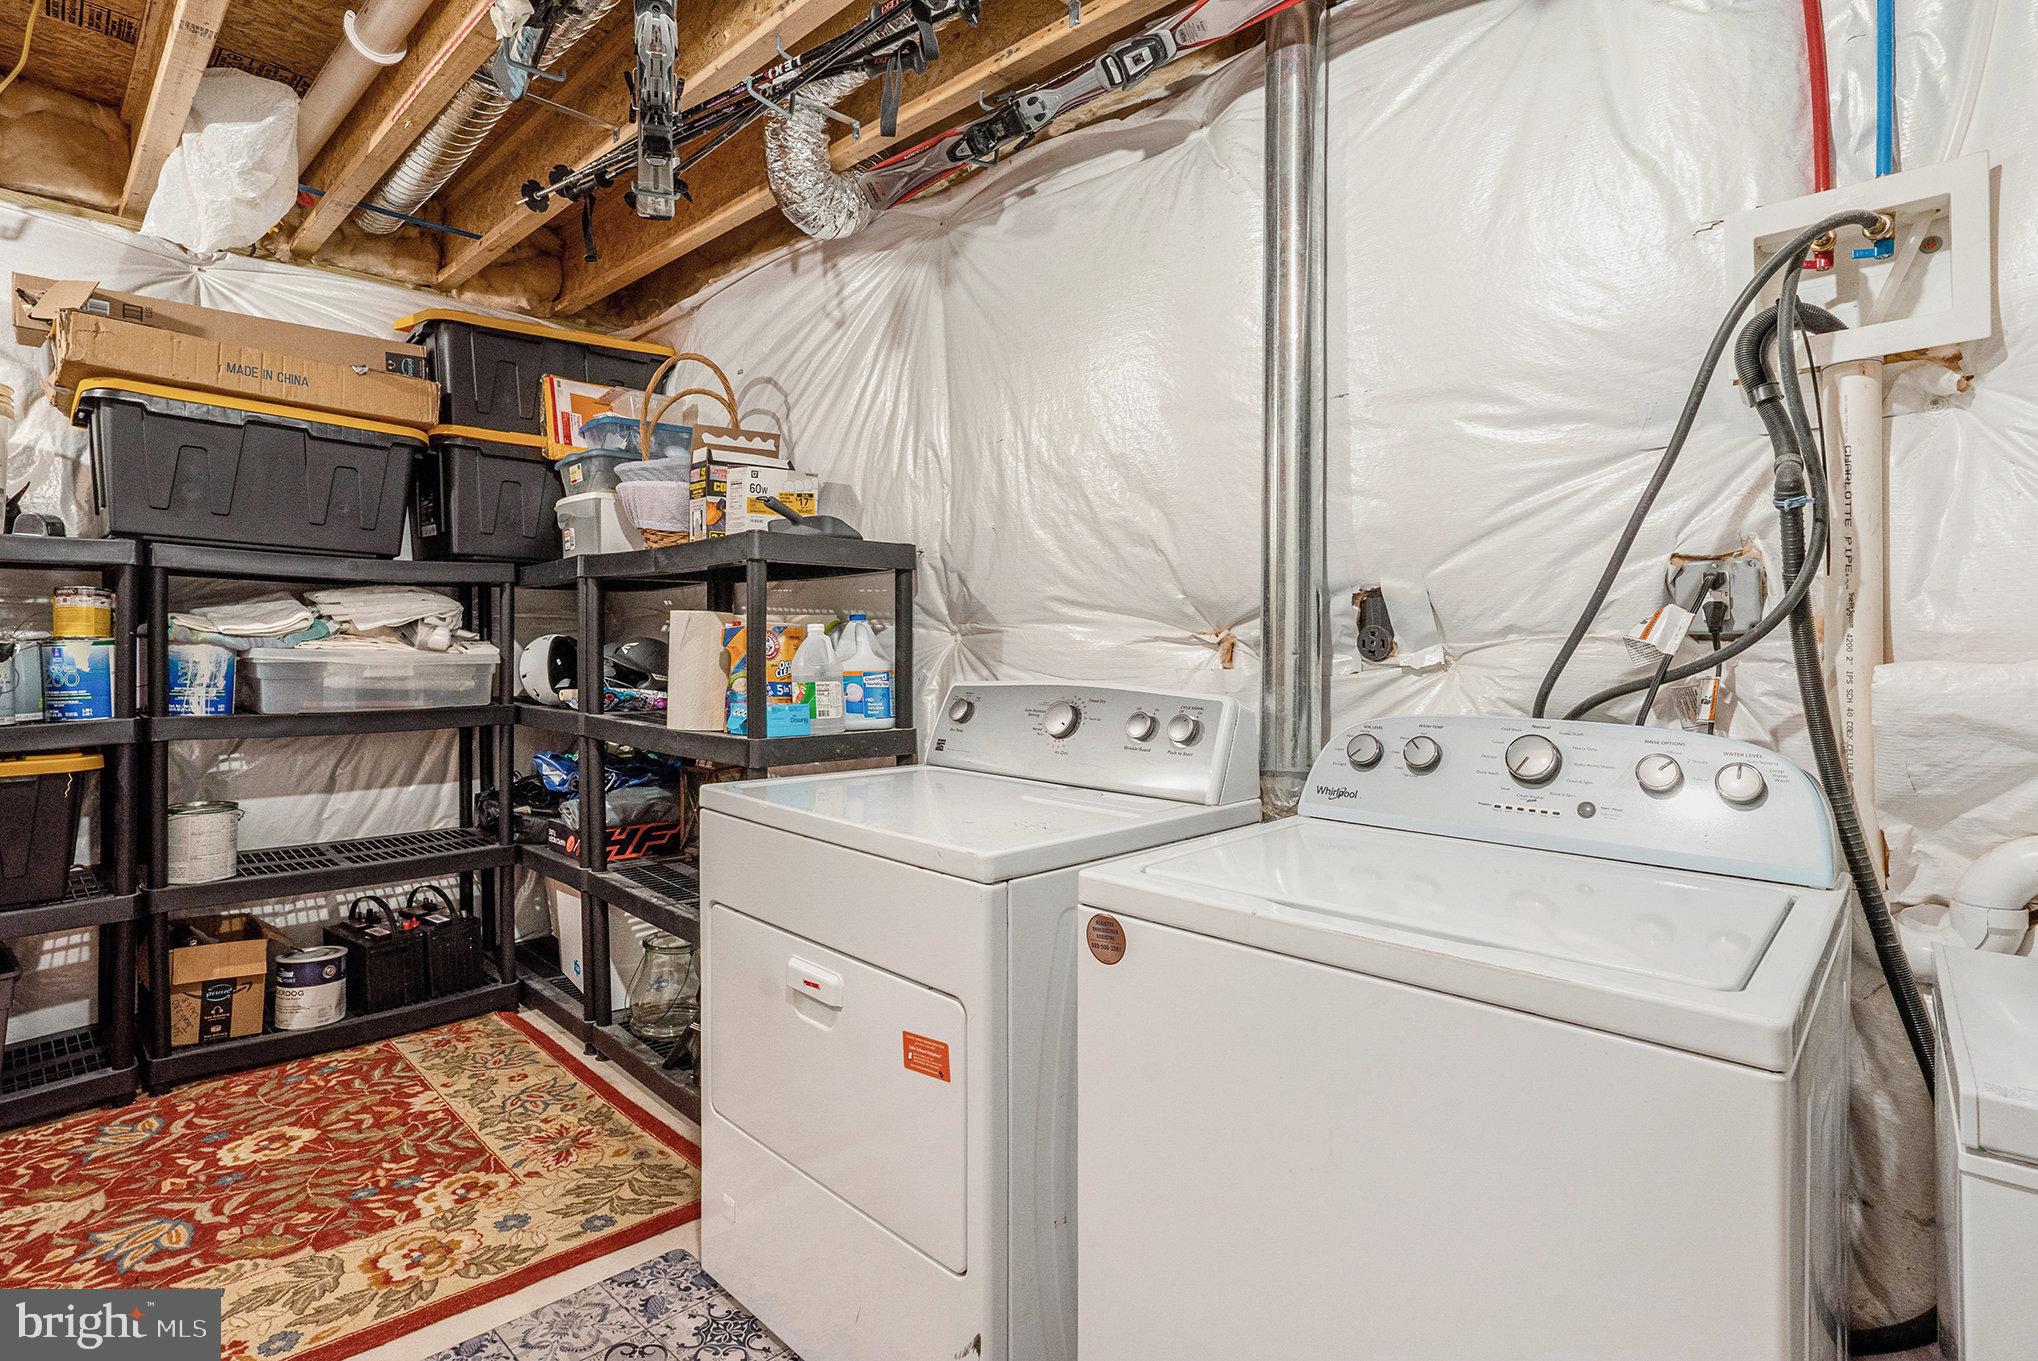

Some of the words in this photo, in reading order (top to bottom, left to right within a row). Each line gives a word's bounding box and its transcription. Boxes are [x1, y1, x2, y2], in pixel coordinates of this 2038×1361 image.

[227, 362, 259, 379] MADE
[263, 368, 274, 381] IN
[277, 371, 310, 387] CHINA
[1844, 445, 1853, 528] CHARLOTTE
[1844, 536, 1853, 574] PIPE
[1845, 706, 1854, 718] 40
[1662, 740, 1686, 748] OPTIONS
[1316, 785, 1359, 801] Whirlpool
